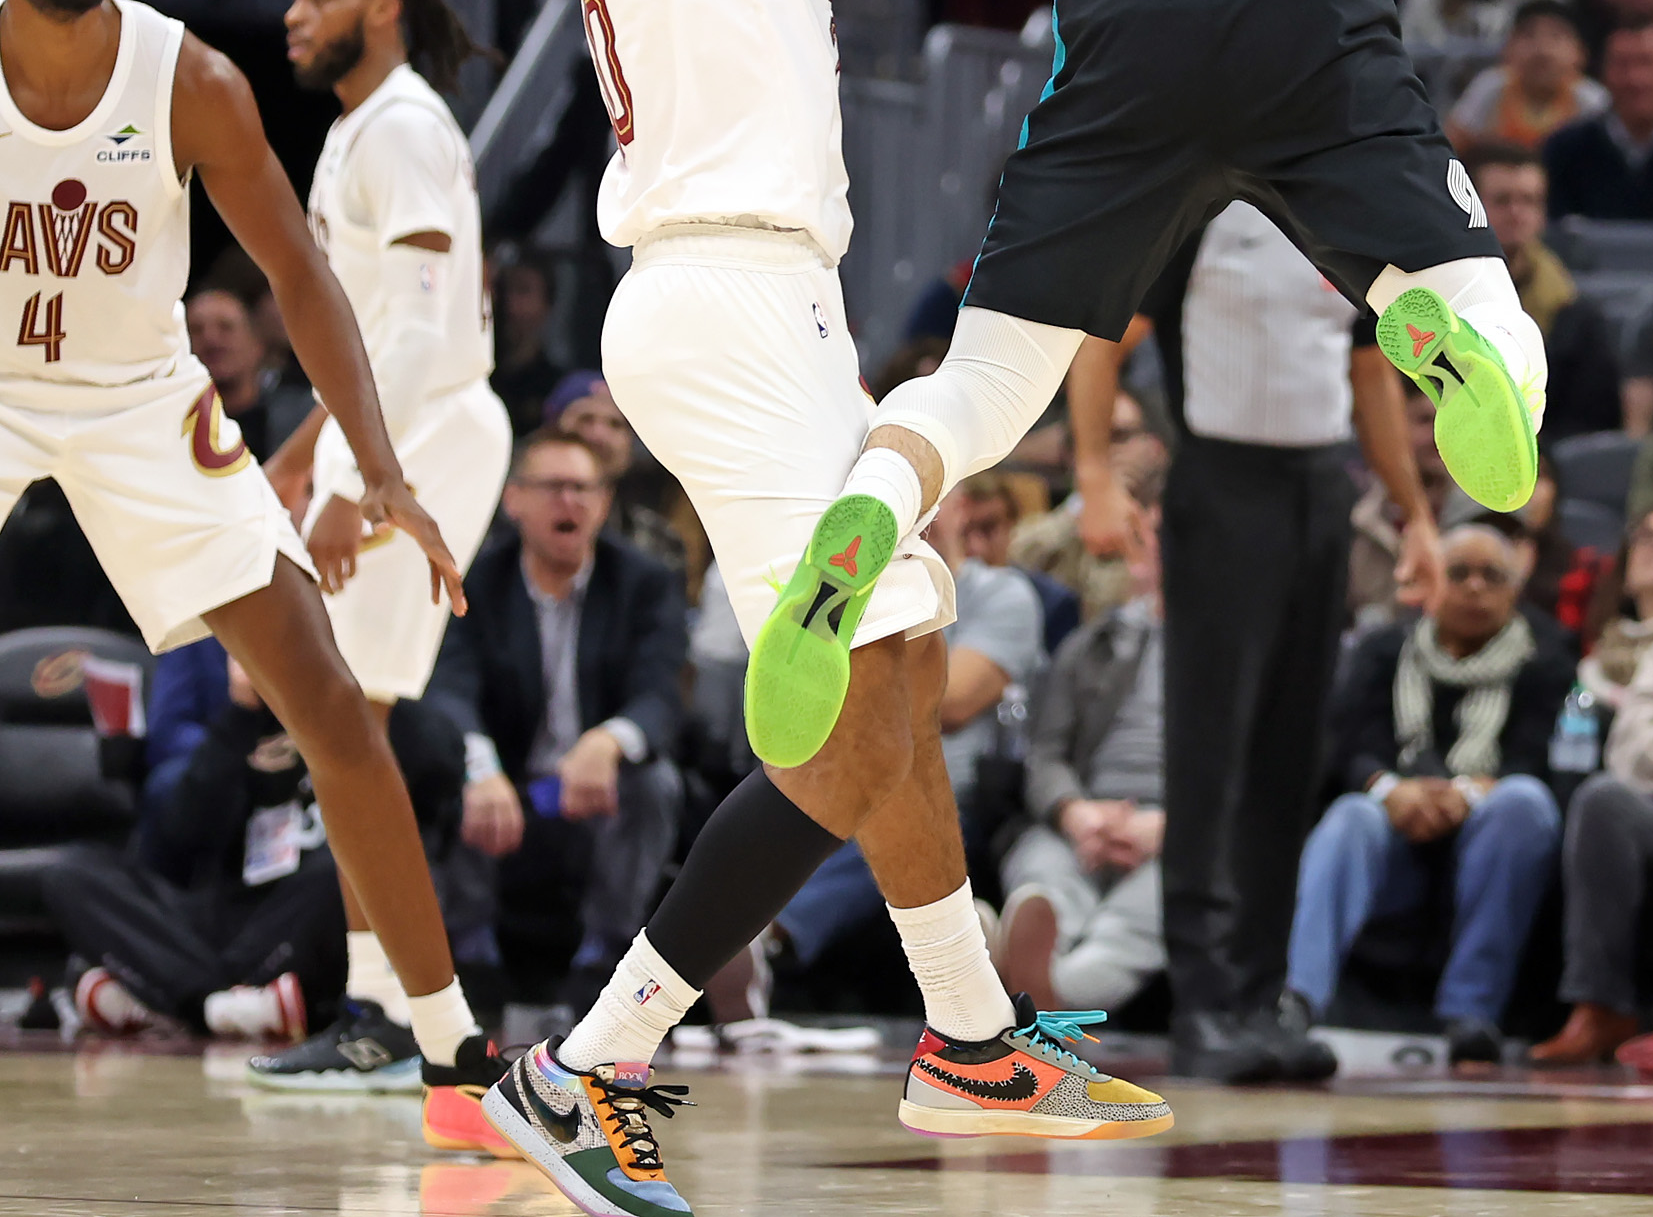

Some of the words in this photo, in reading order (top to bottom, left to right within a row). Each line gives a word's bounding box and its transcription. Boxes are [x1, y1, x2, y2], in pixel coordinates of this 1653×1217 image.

[96, 150, 151, 162] CLIFFS
[17, 289, 67, 363] 4
[618, 1071, 643, 1082] BOOK
